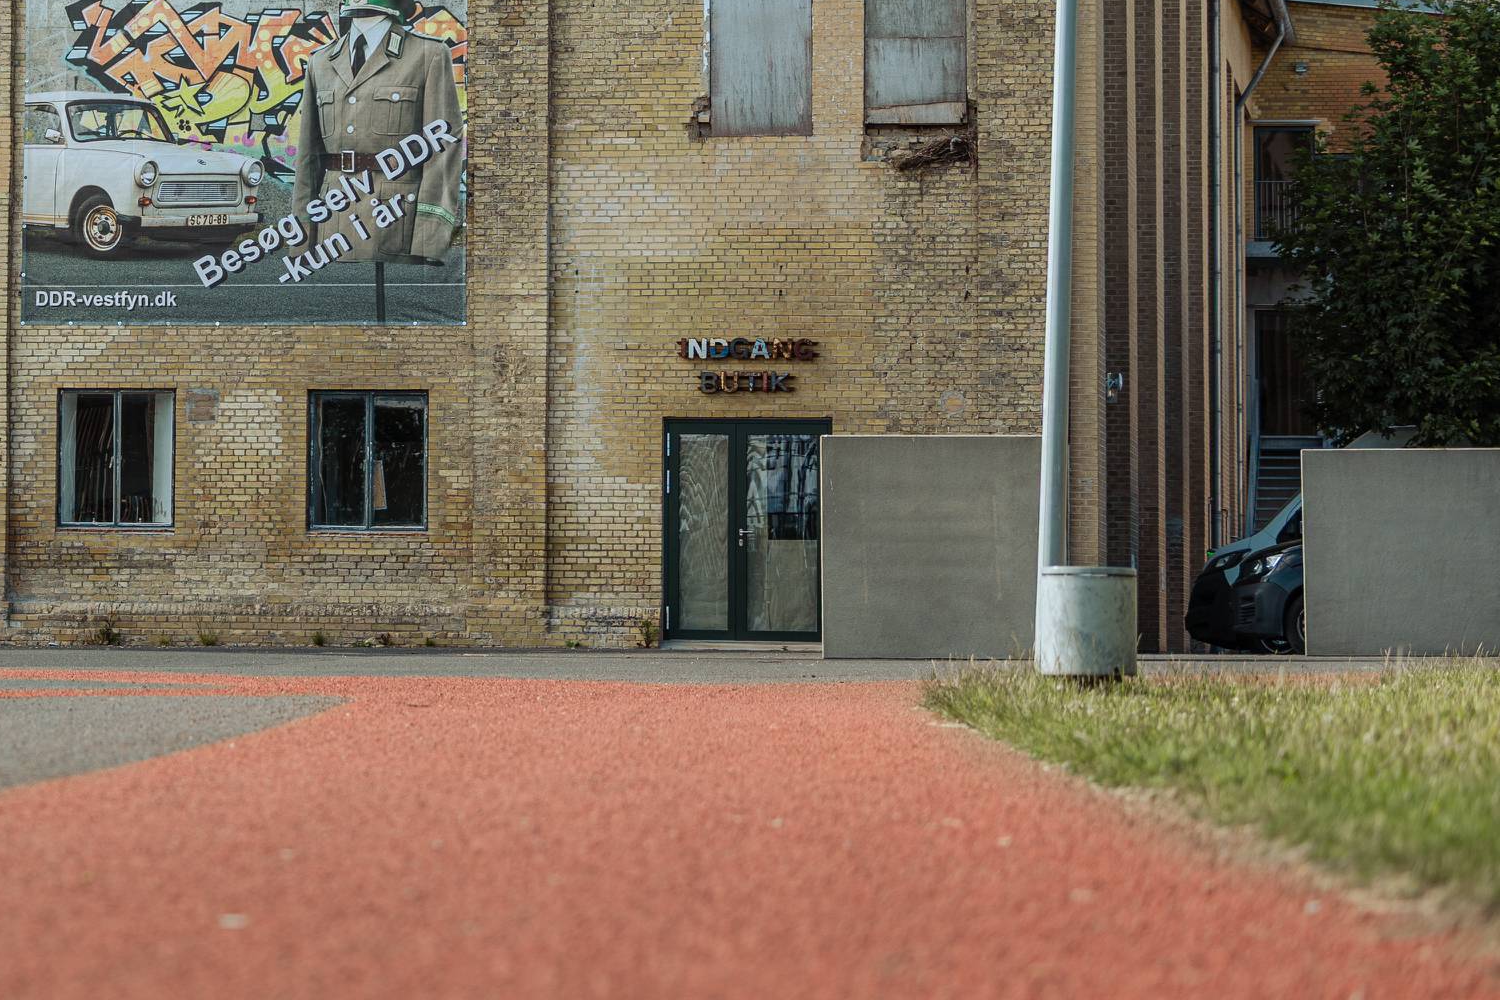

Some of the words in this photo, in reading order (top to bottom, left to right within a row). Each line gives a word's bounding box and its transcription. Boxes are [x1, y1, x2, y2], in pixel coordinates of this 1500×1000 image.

[192, 212, 304, 288] Besøg
[306, 169, 373, 223] selv
[375, 118, 458, 181] DDR
[278, 231, 351, 284] -kun
[348, 212, 370, 241] i
[35, 290, 178, 311] DDR-vestfyn.dk
[679, 337, 815, 361] INDGANG
[700, 370, 791, 394] BUTIK
